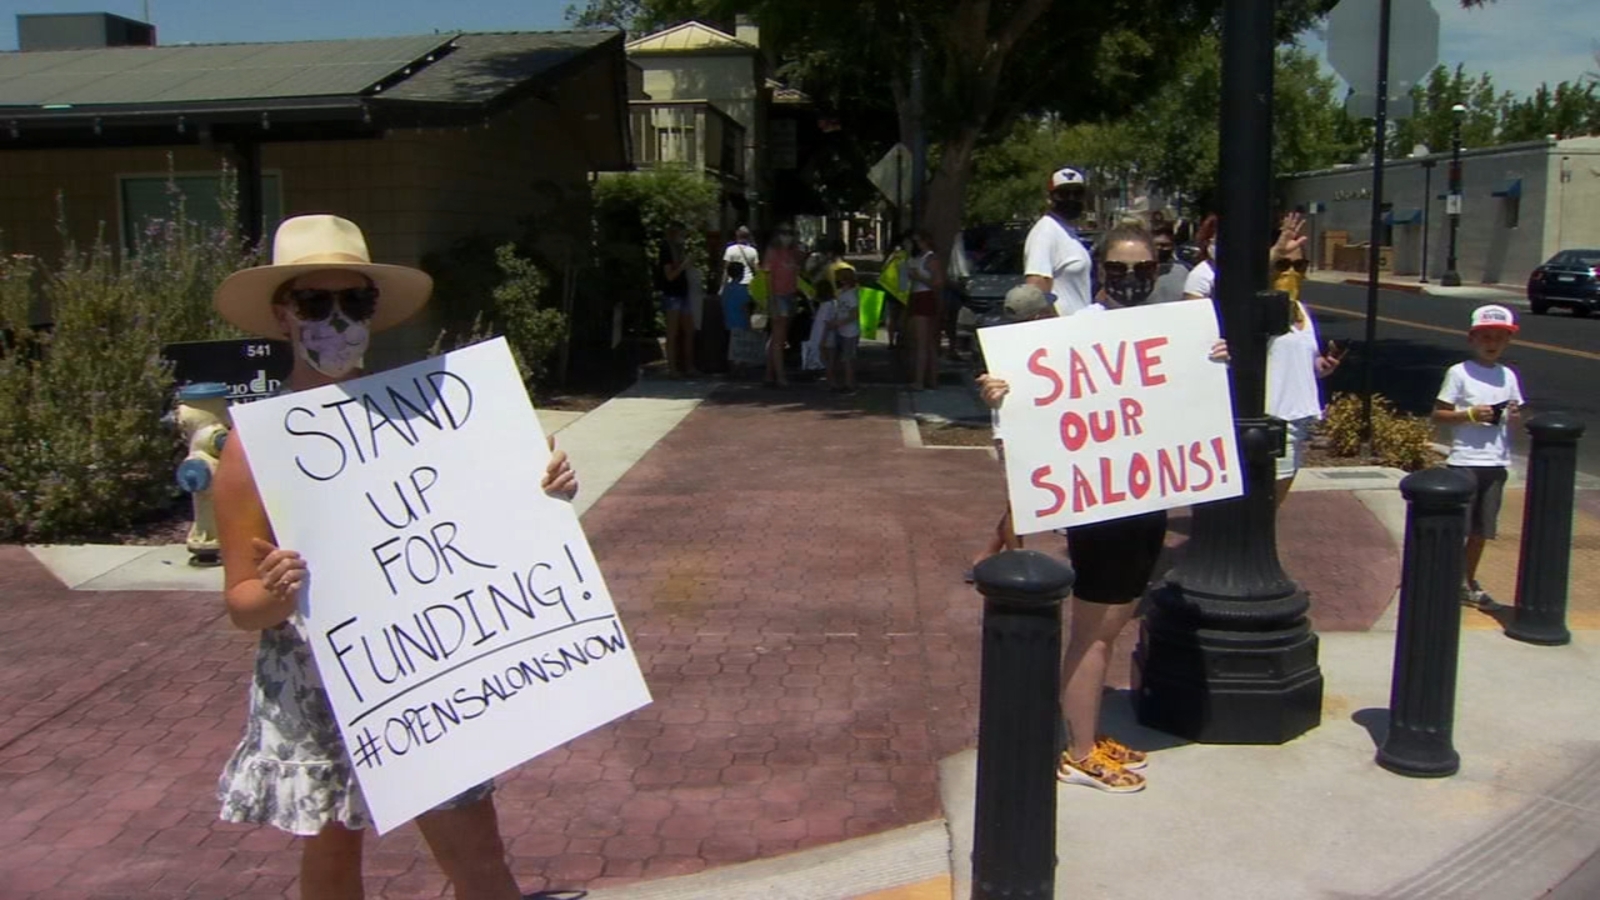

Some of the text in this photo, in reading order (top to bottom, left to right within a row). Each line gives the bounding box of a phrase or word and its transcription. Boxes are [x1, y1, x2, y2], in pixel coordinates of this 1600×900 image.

[247, 343, 271, 357] 541
[1027, 336, 1169, 407] SAVE
[284, 370, 473, 481] STAND
[1059, 397, 1144, 452] OUR
[365, 465, 439, 529] UP
[1030, 436, 1228, 518] SALONS!
[371, 521, 498, 595] FOR
[325, 544, 593, 703] FUNDING!
[352, 620, 626, 769] #OPENSALONSNOW
